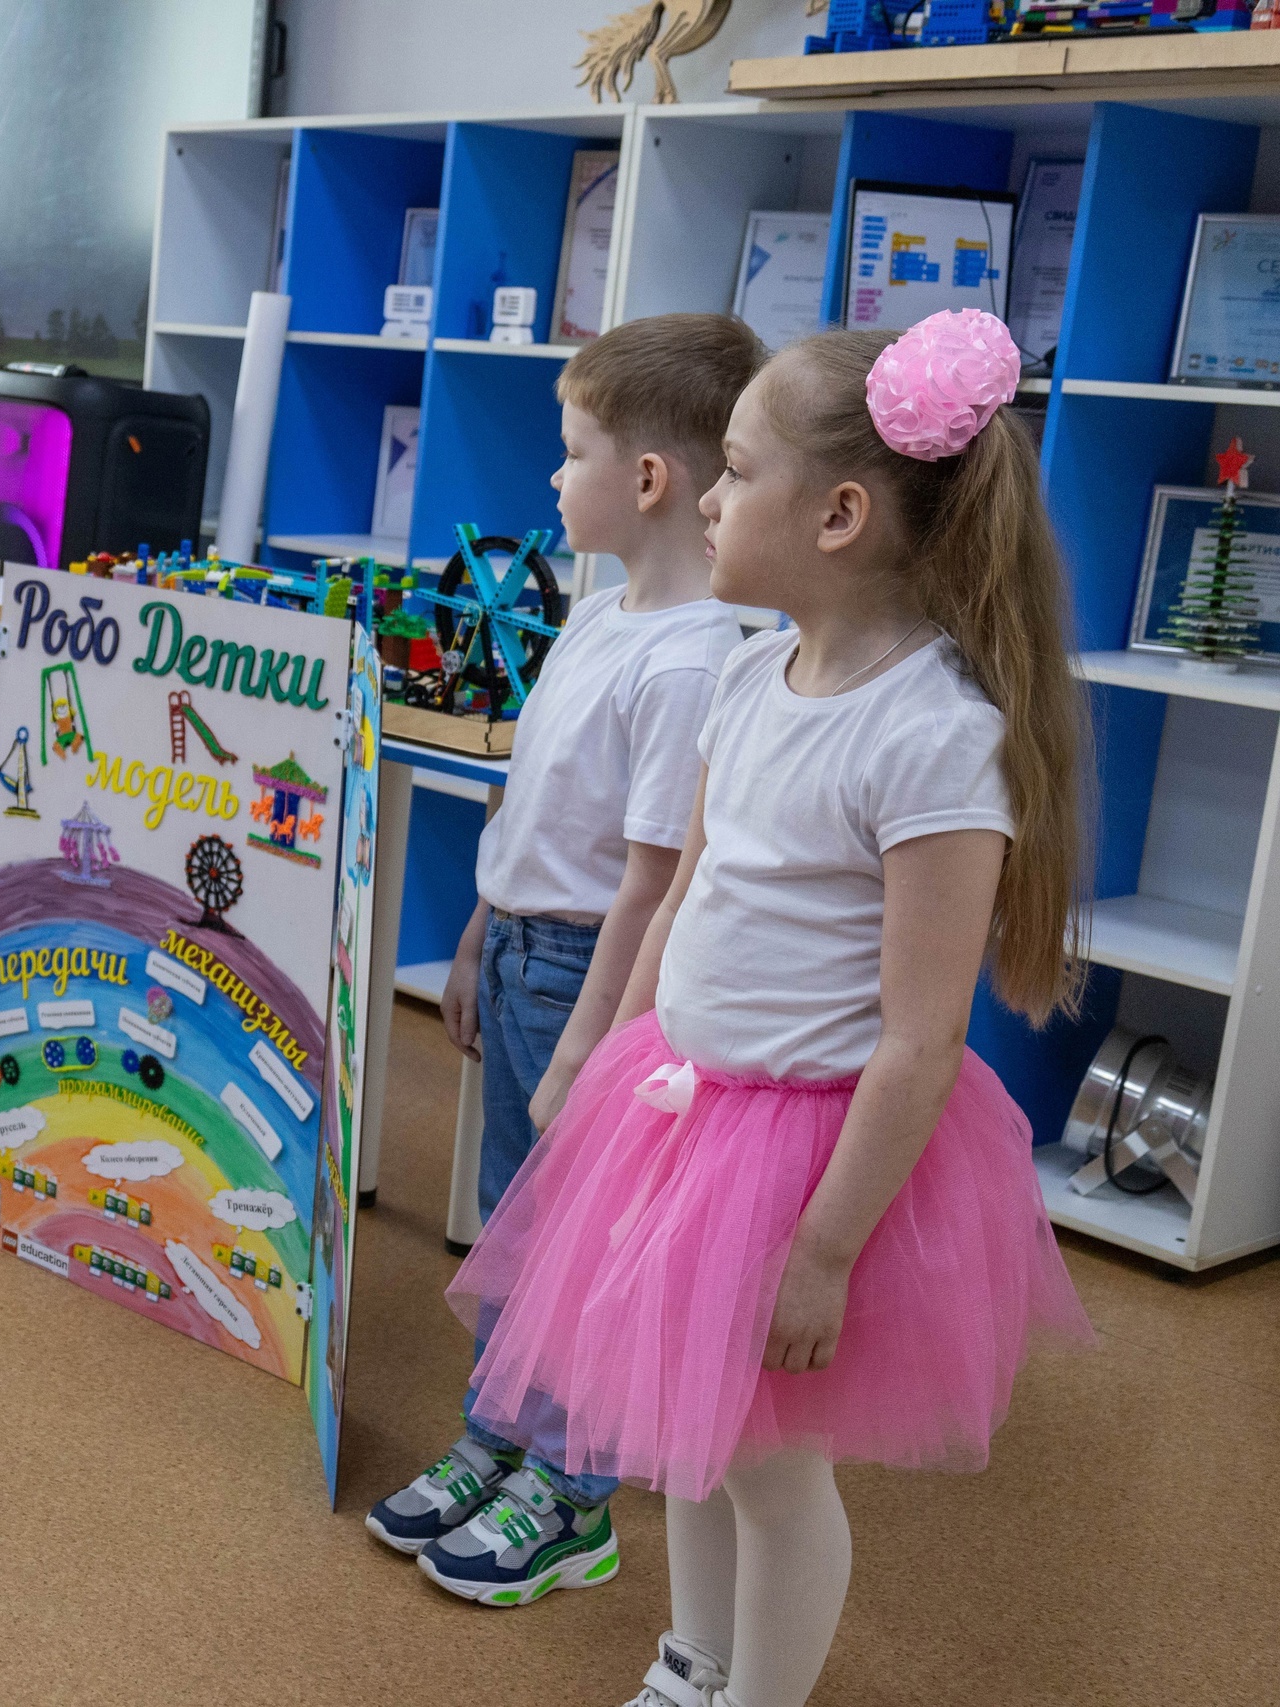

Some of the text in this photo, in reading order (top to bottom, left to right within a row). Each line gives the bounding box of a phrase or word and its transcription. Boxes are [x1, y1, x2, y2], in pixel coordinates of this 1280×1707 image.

[13, 580, 120, 666] Робо
[132, 601, 329, 710] Детки
[86, 752, 239, 830] модель
[160, 929, 308, 1071] механизмы
[58, 1080, 205, 1146] программирование
[225, 1198, 273, 1217] Тренажёр
[20, 1241, 68, 1271] education
